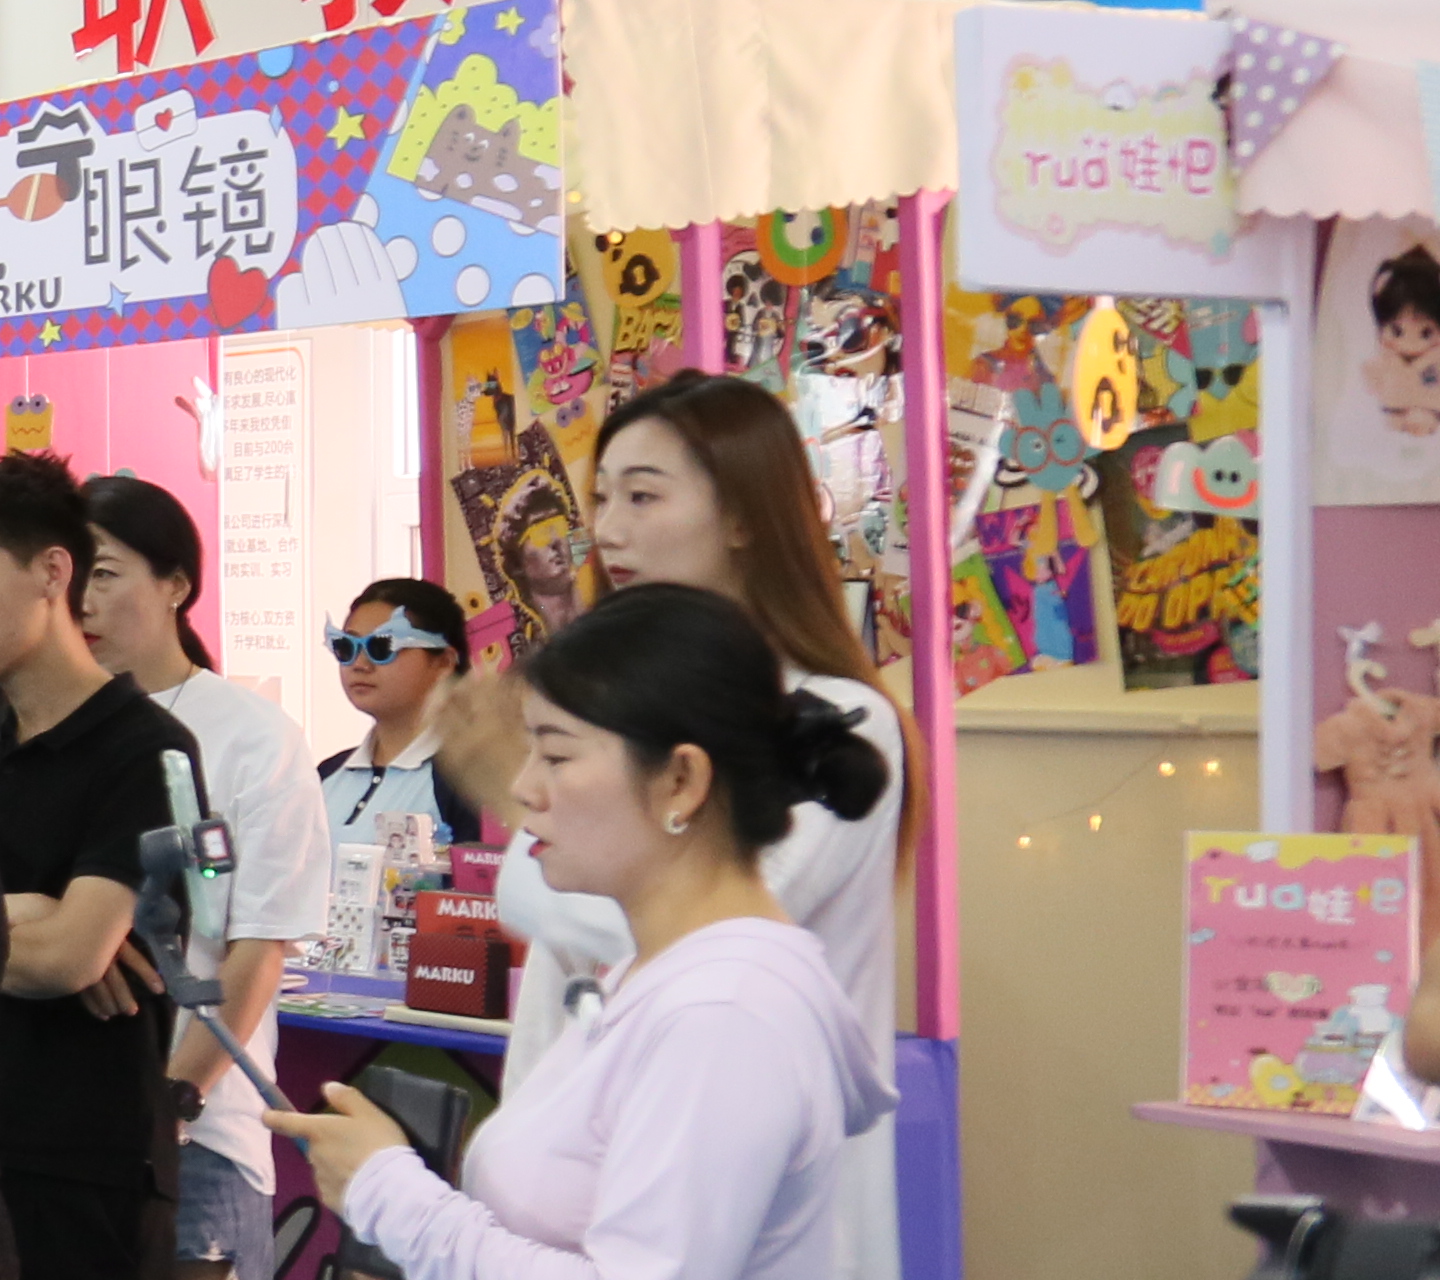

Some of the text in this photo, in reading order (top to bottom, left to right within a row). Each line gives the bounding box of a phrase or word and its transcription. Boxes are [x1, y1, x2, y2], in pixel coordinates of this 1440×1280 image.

[463, 852, 506, 866] MARK
[436, 897, 499, 921] MARK
[414, 964, 475, 986] MARKU
